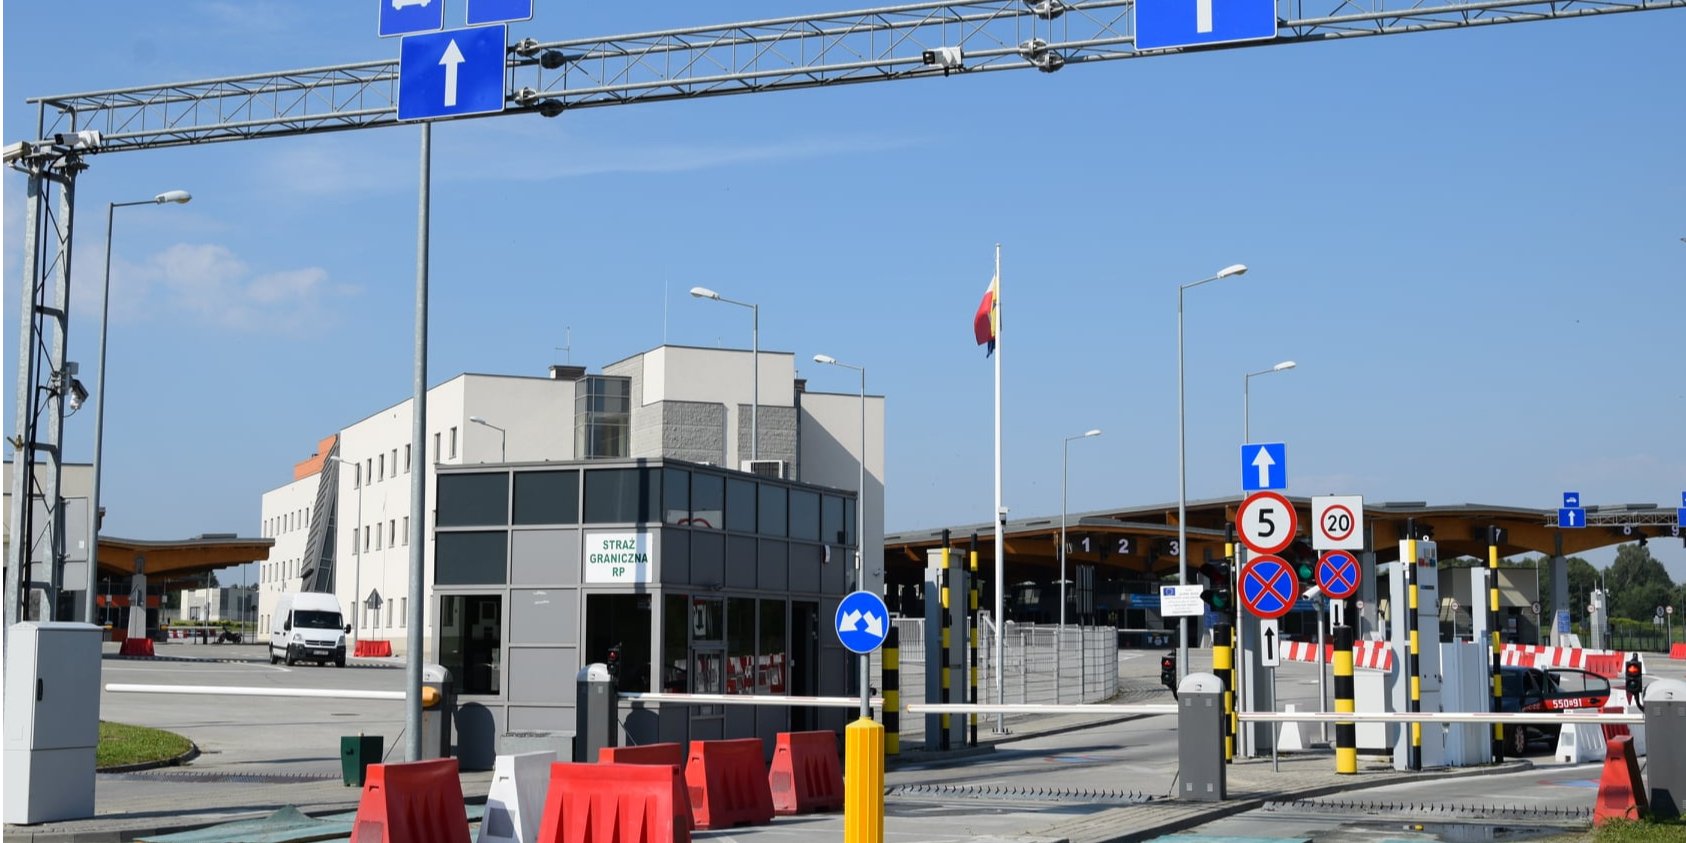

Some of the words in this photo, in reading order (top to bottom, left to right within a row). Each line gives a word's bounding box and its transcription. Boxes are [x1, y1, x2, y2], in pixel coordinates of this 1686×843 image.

[1257, 508, 1275, 538] 5
[1327, 514, 1350, 532] 20
[603, 538, 635, 550] STRAŻ
[1082, 536, 1090, 552] 1
[1118, 538, 1129, 554] 2
[1169, 540, 1180, 556] 3
[590, 553, 648, 563] GRANICZNA
[612, 567, 625, 576] RP
